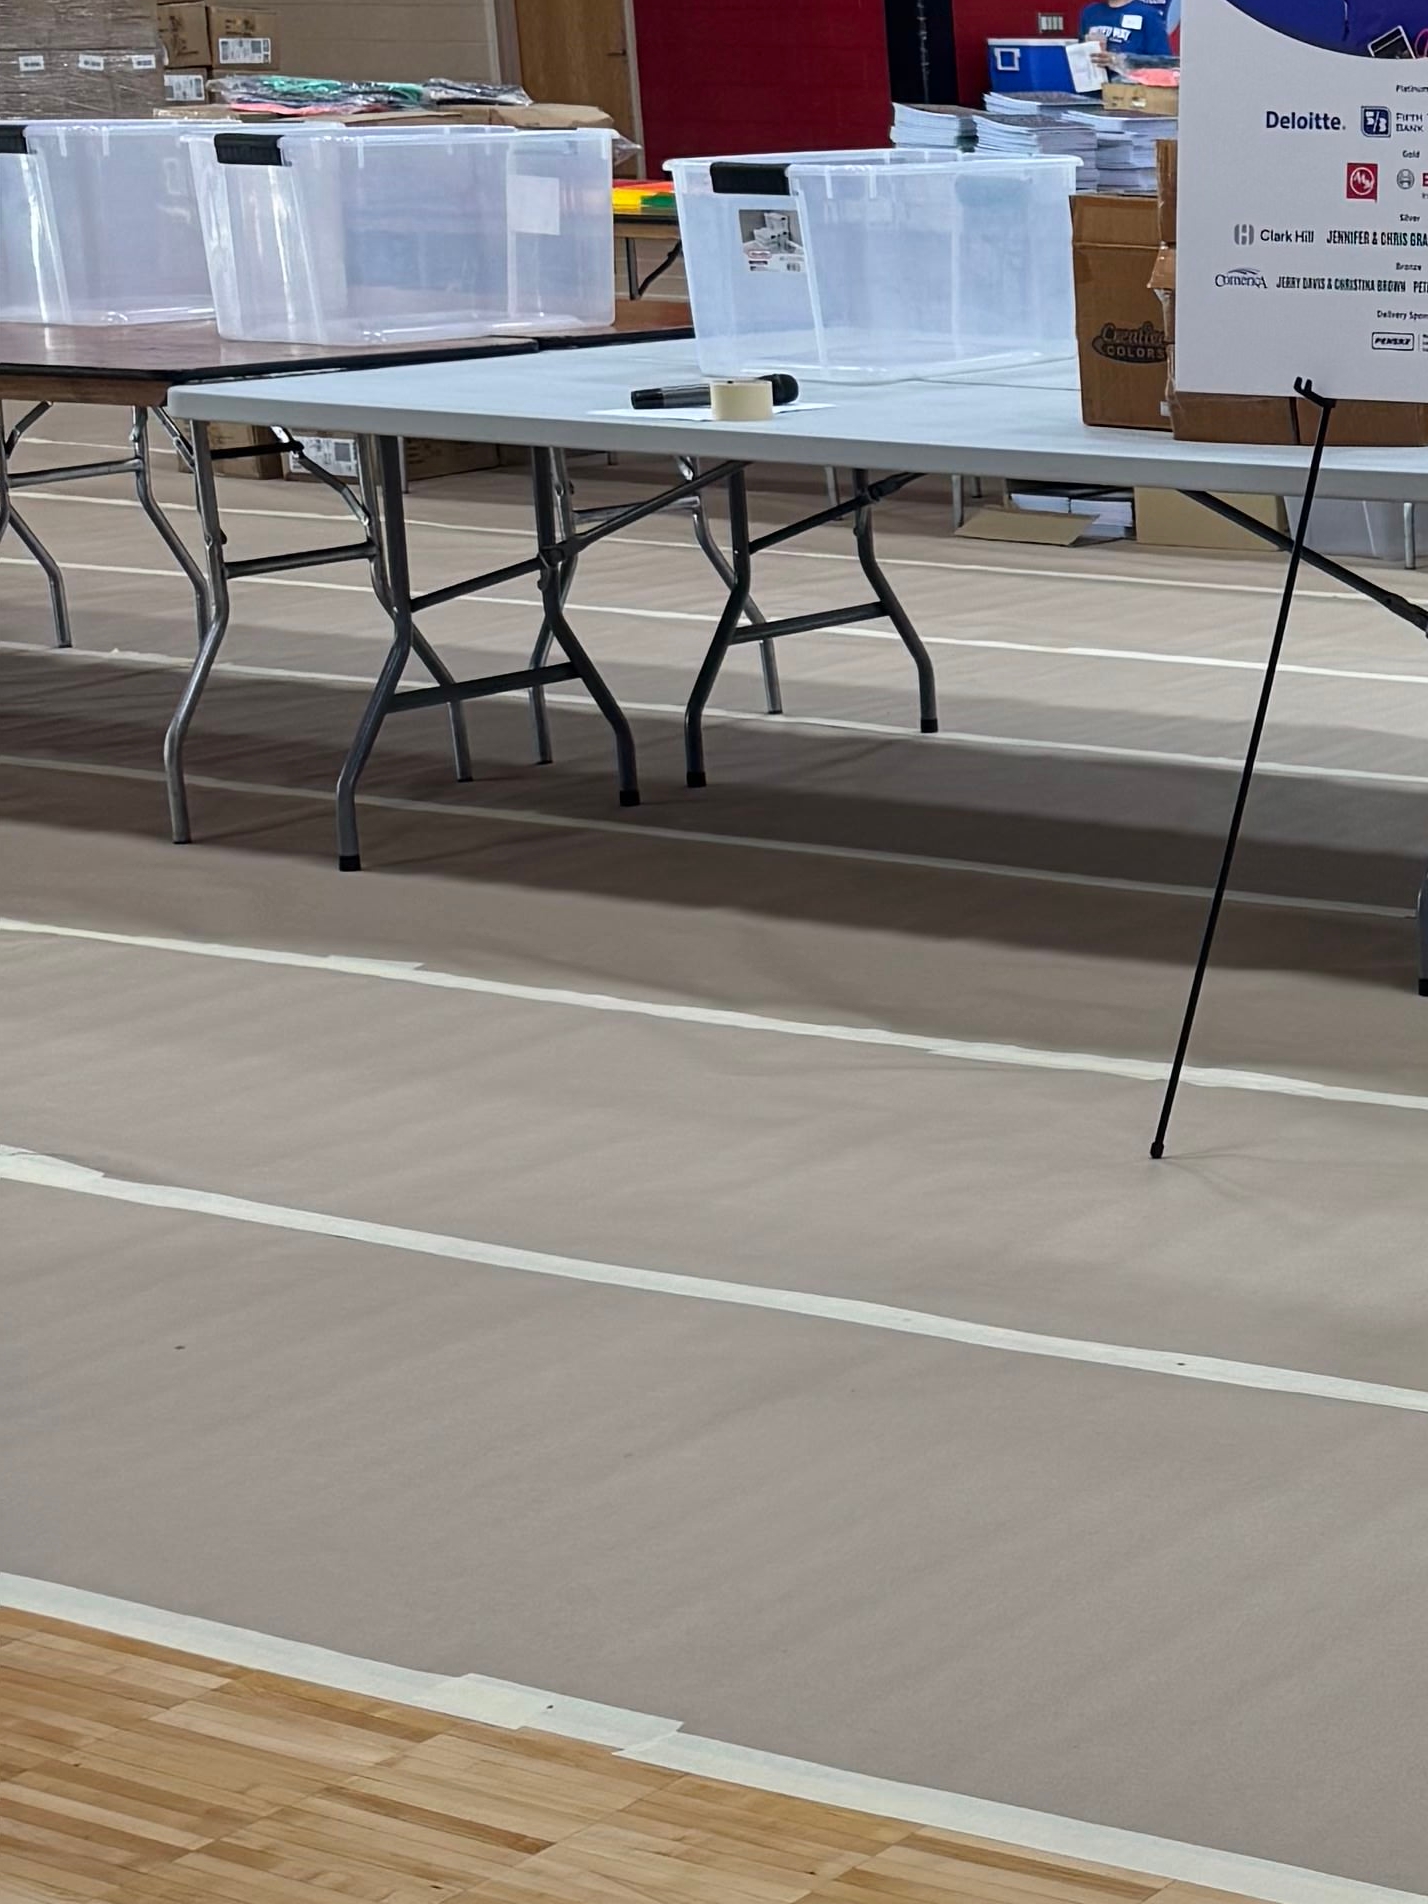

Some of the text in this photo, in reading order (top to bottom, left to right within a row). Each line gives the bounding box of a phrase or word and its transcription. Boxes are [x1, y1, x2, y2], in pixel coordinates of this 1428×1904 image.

[1266, 111, 1346, 130] Deloitte.
[1396, 113, 1423, 122] FIFTH
[1396, 124, 1424, 133] BANK
[1402, 150, 1420, 158] Gold
[1260, 229, 1314, 243] Clark Hill
[1327, 230, 1370, 245] JENNIFER
[1372, 231, 1378, 245] &
[1381, 232, 1408, 246] CHRIS
[1276, 276, 1300, 289] JERRY
[1302, 277, 1325, 290] DAVIS
[1327, 277, 1333, 290] &
[1106, 346, 1166, 358] COLORS
